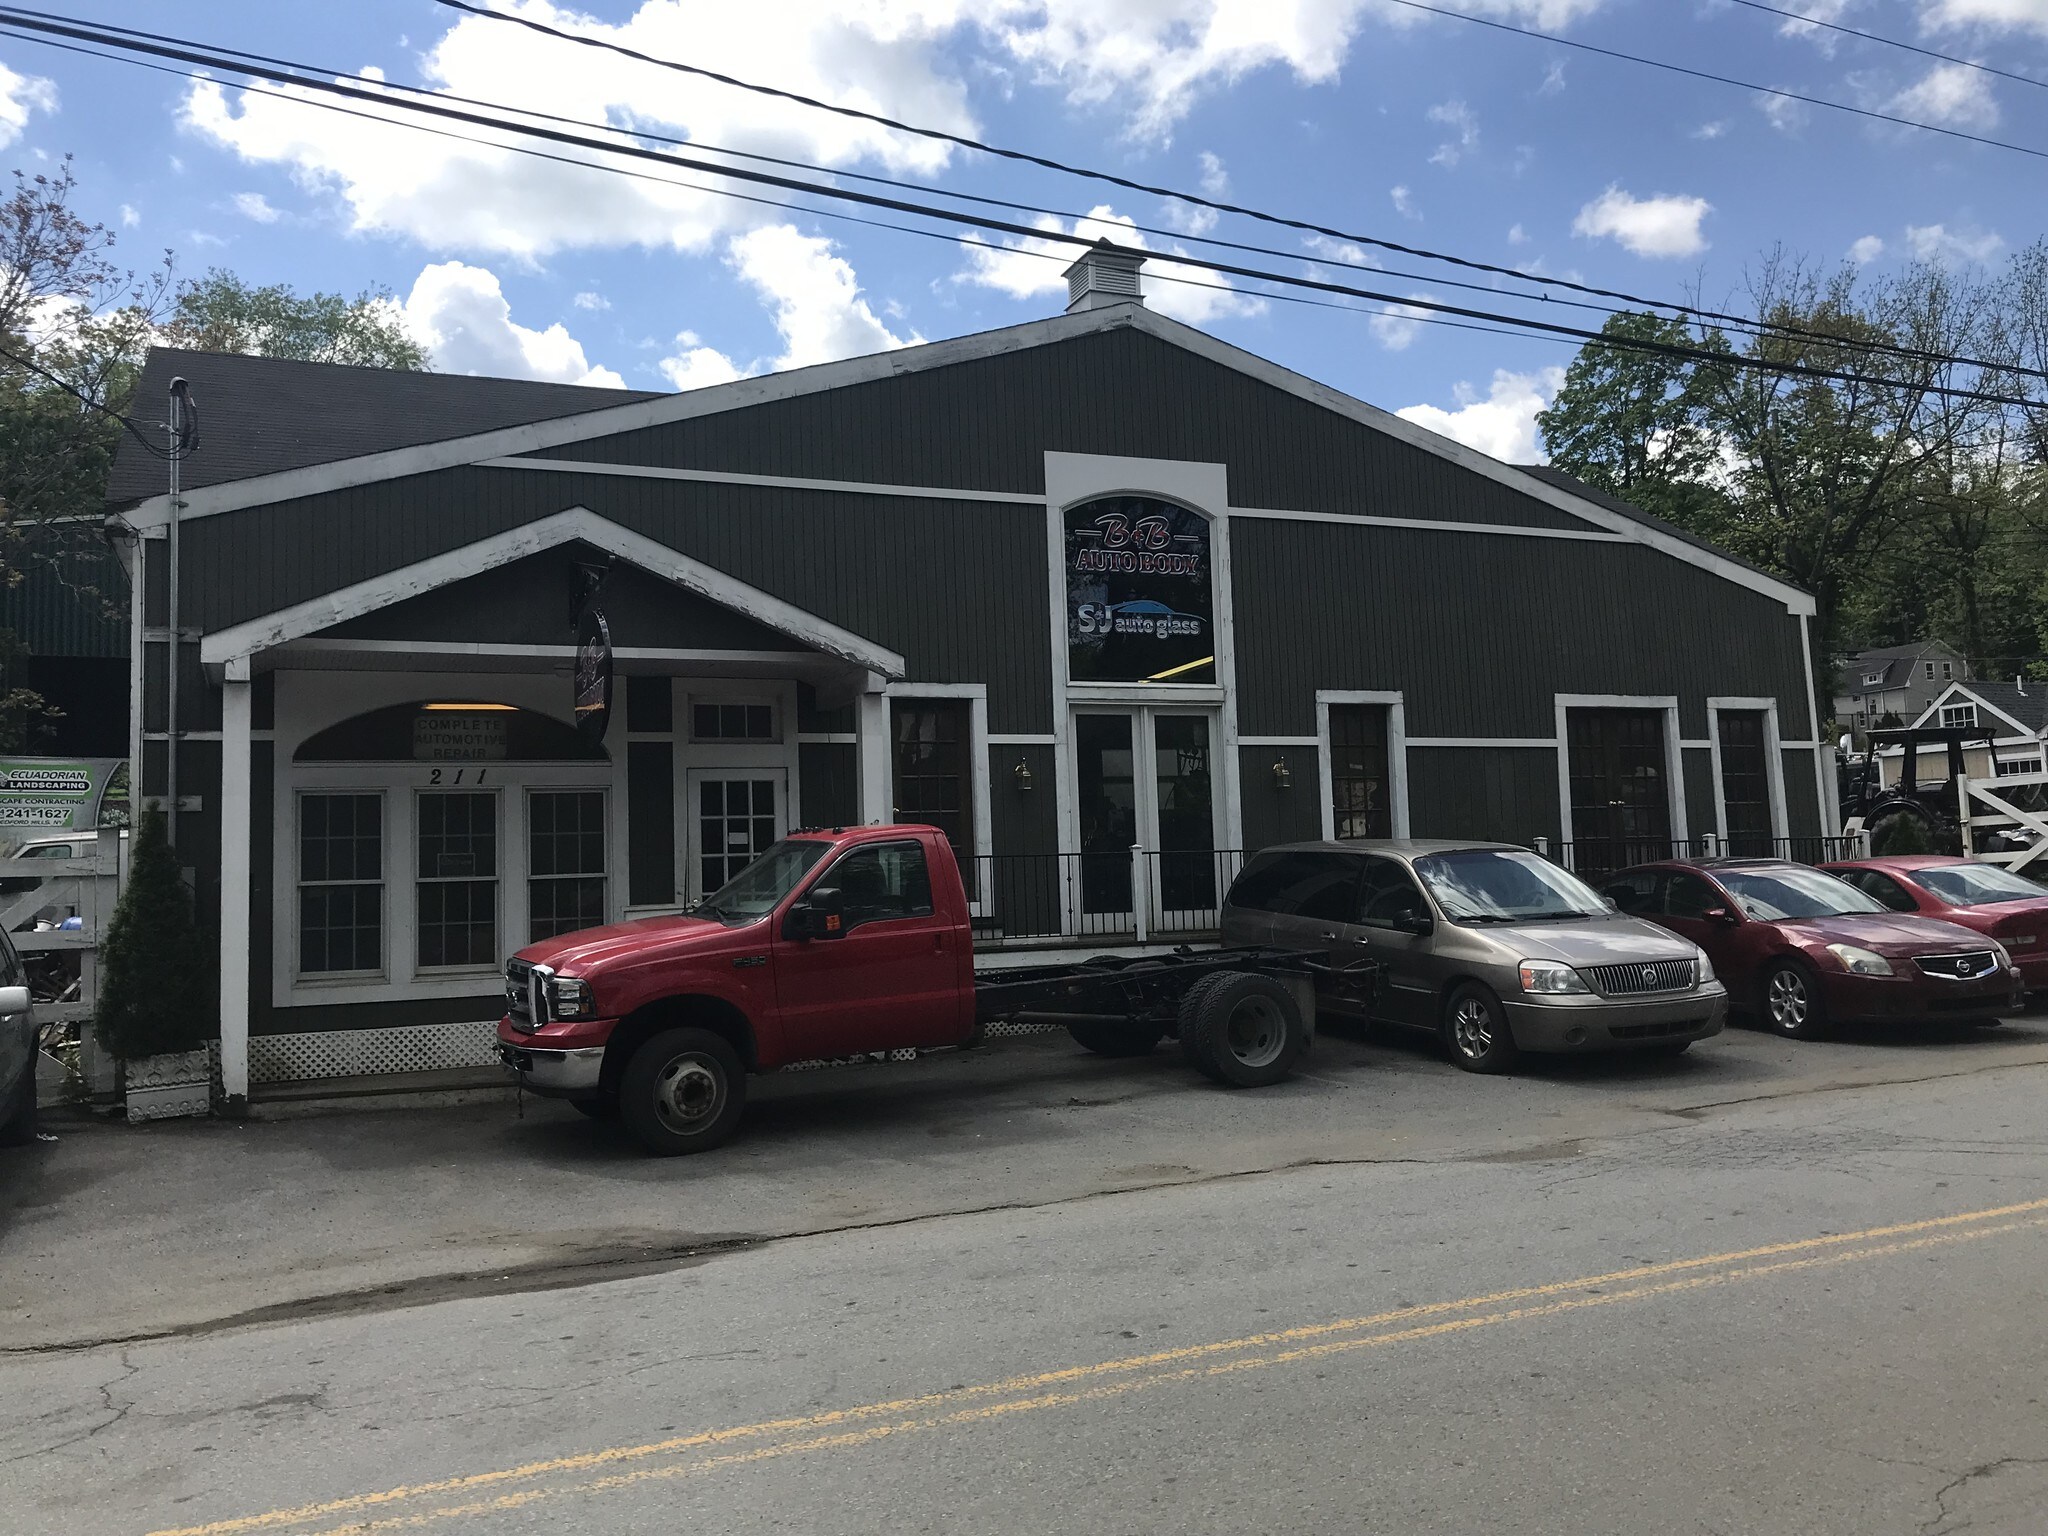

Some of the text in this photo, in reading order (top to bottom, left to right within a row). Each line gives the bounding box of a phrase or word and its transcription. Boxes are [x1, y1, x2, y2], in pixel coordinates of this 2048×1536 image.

[1075, 549, 1199, 576] AUTO BODY
[1115, 615, 1154, 633] auto
[1156, 613, 1200, 639] glass
[417, 719, 501, 730] COMPLETE
[415, 734, 506, 745] AUTOMOTIVE
[433, 748, 487, 760] REPAIR
[10, 770, 86, 780] ECUADORIAN
[10, 781, 86, 789] LANDSCAPING
